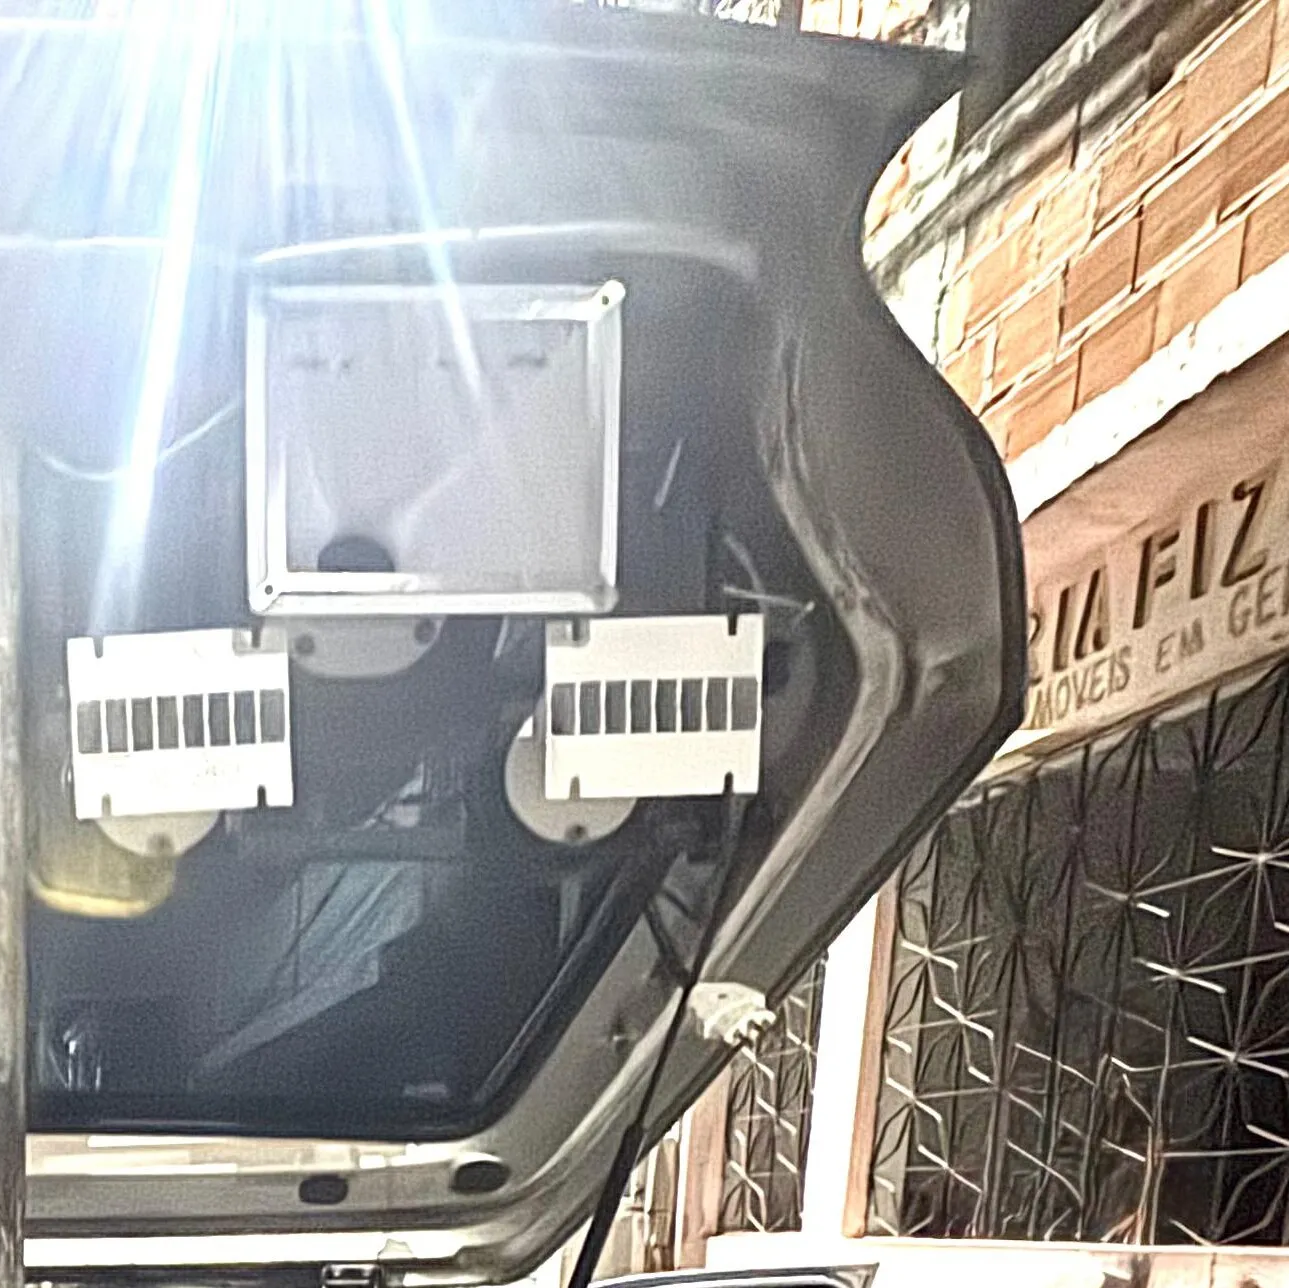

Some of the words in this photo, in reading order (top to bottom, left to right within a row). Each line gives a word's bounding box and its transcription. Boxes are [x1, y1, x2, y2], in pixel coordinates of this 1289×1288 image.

[1131, 460, 1282, 631] FIZ
[1155, 617, 1204, 674] EM
[1228, 558, 1289, 638] GE
